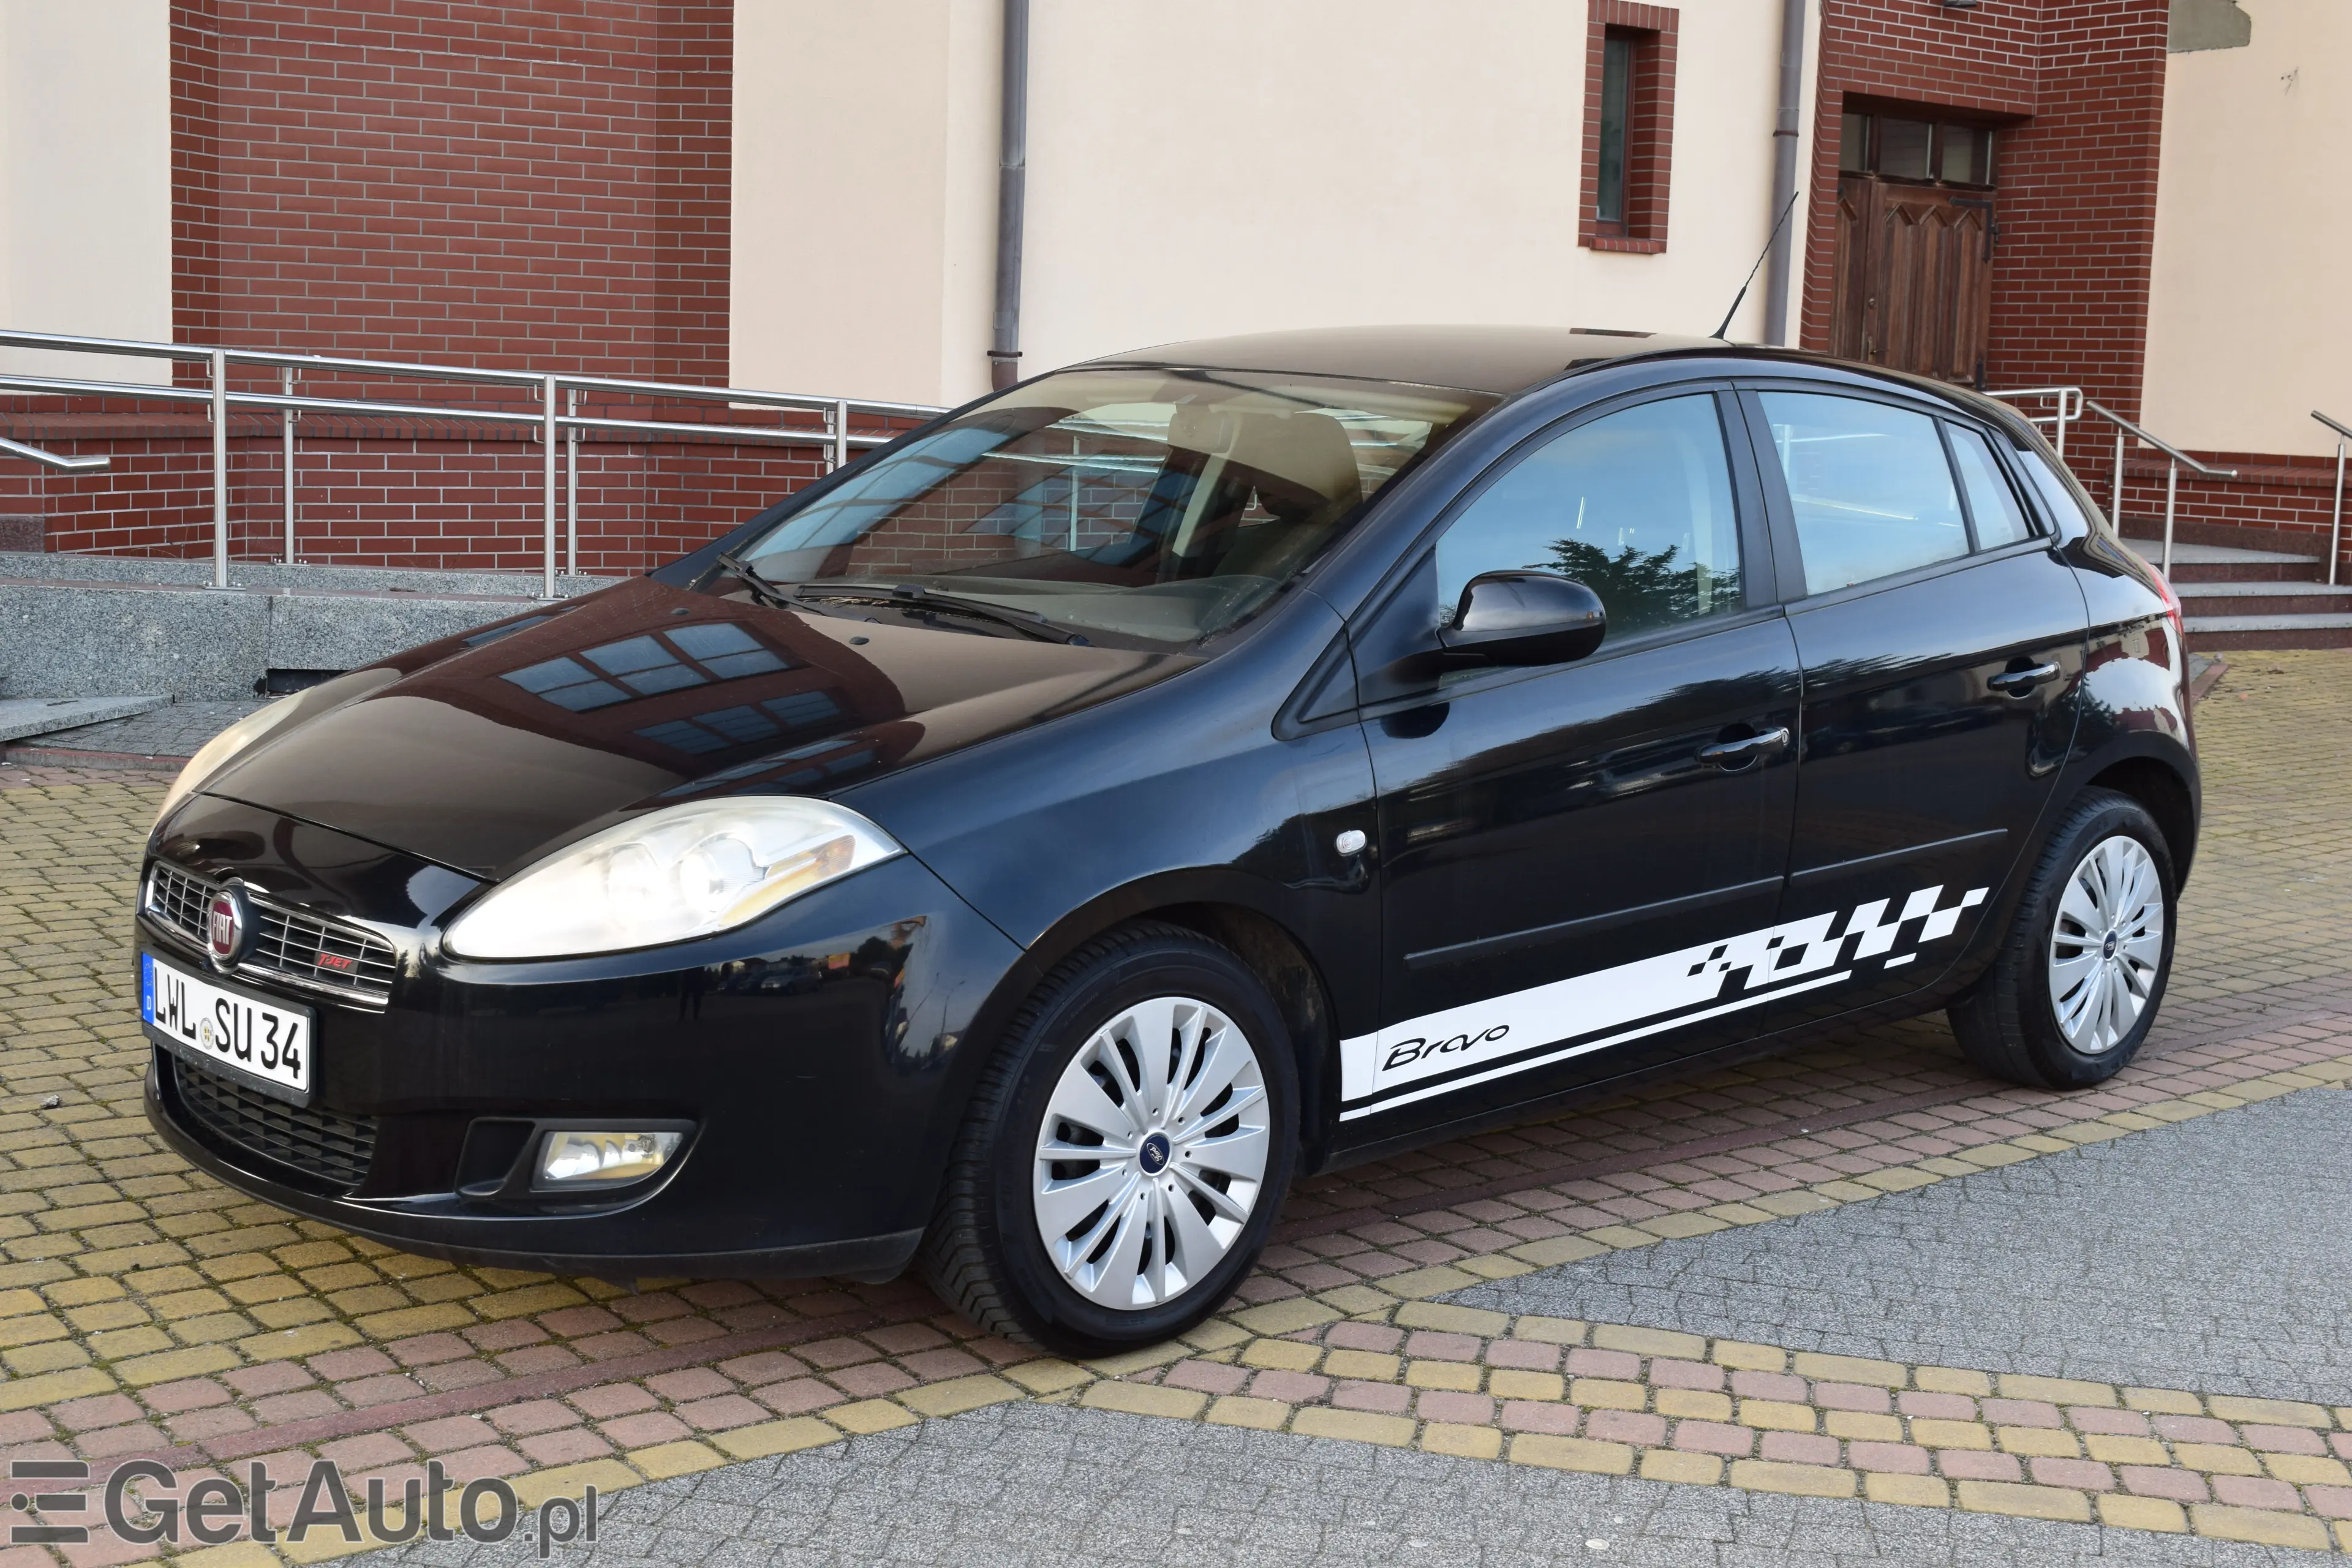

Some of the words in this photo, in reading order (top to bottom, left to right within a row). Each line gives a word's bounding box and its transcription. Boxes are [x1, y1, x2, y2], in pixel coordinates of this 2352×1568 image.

[213, 911, 233, 945] FIAT
[146, 995, 152, 1011] D
[154, 967, 196, 1040] LWL
[215, 997, 252, 1062] SU
[260, 1012, 301, 1079] 34
[1382, 1025, 1510, 1072] Bravo
